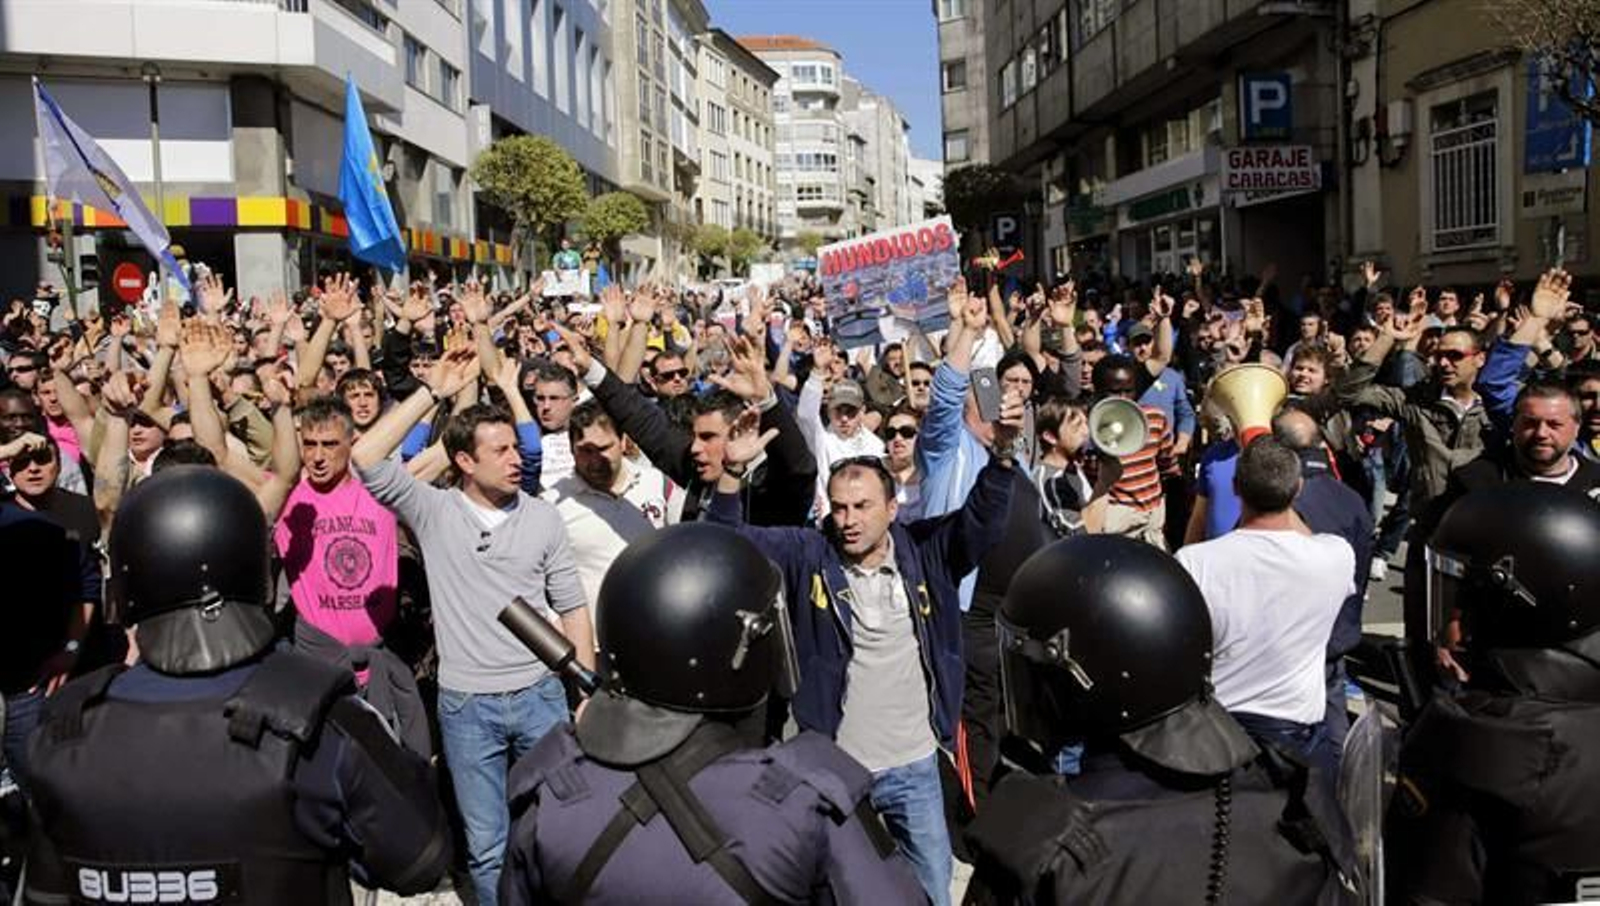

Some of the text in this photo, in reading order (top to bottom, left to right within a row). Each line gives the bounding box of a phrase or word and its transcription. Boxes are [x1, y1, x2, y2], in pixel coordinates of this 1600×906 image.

[1250, 81, 1287, 123] P
[1228, 149, 1309, 169] GARAJE
[1228, 171, 1312, 188] CARACAS
[997, 216, 1016, 240] P
[822, 222, 953, 277] HUNDIDOS
[314, 515, 377, 536] FRANKLIN
